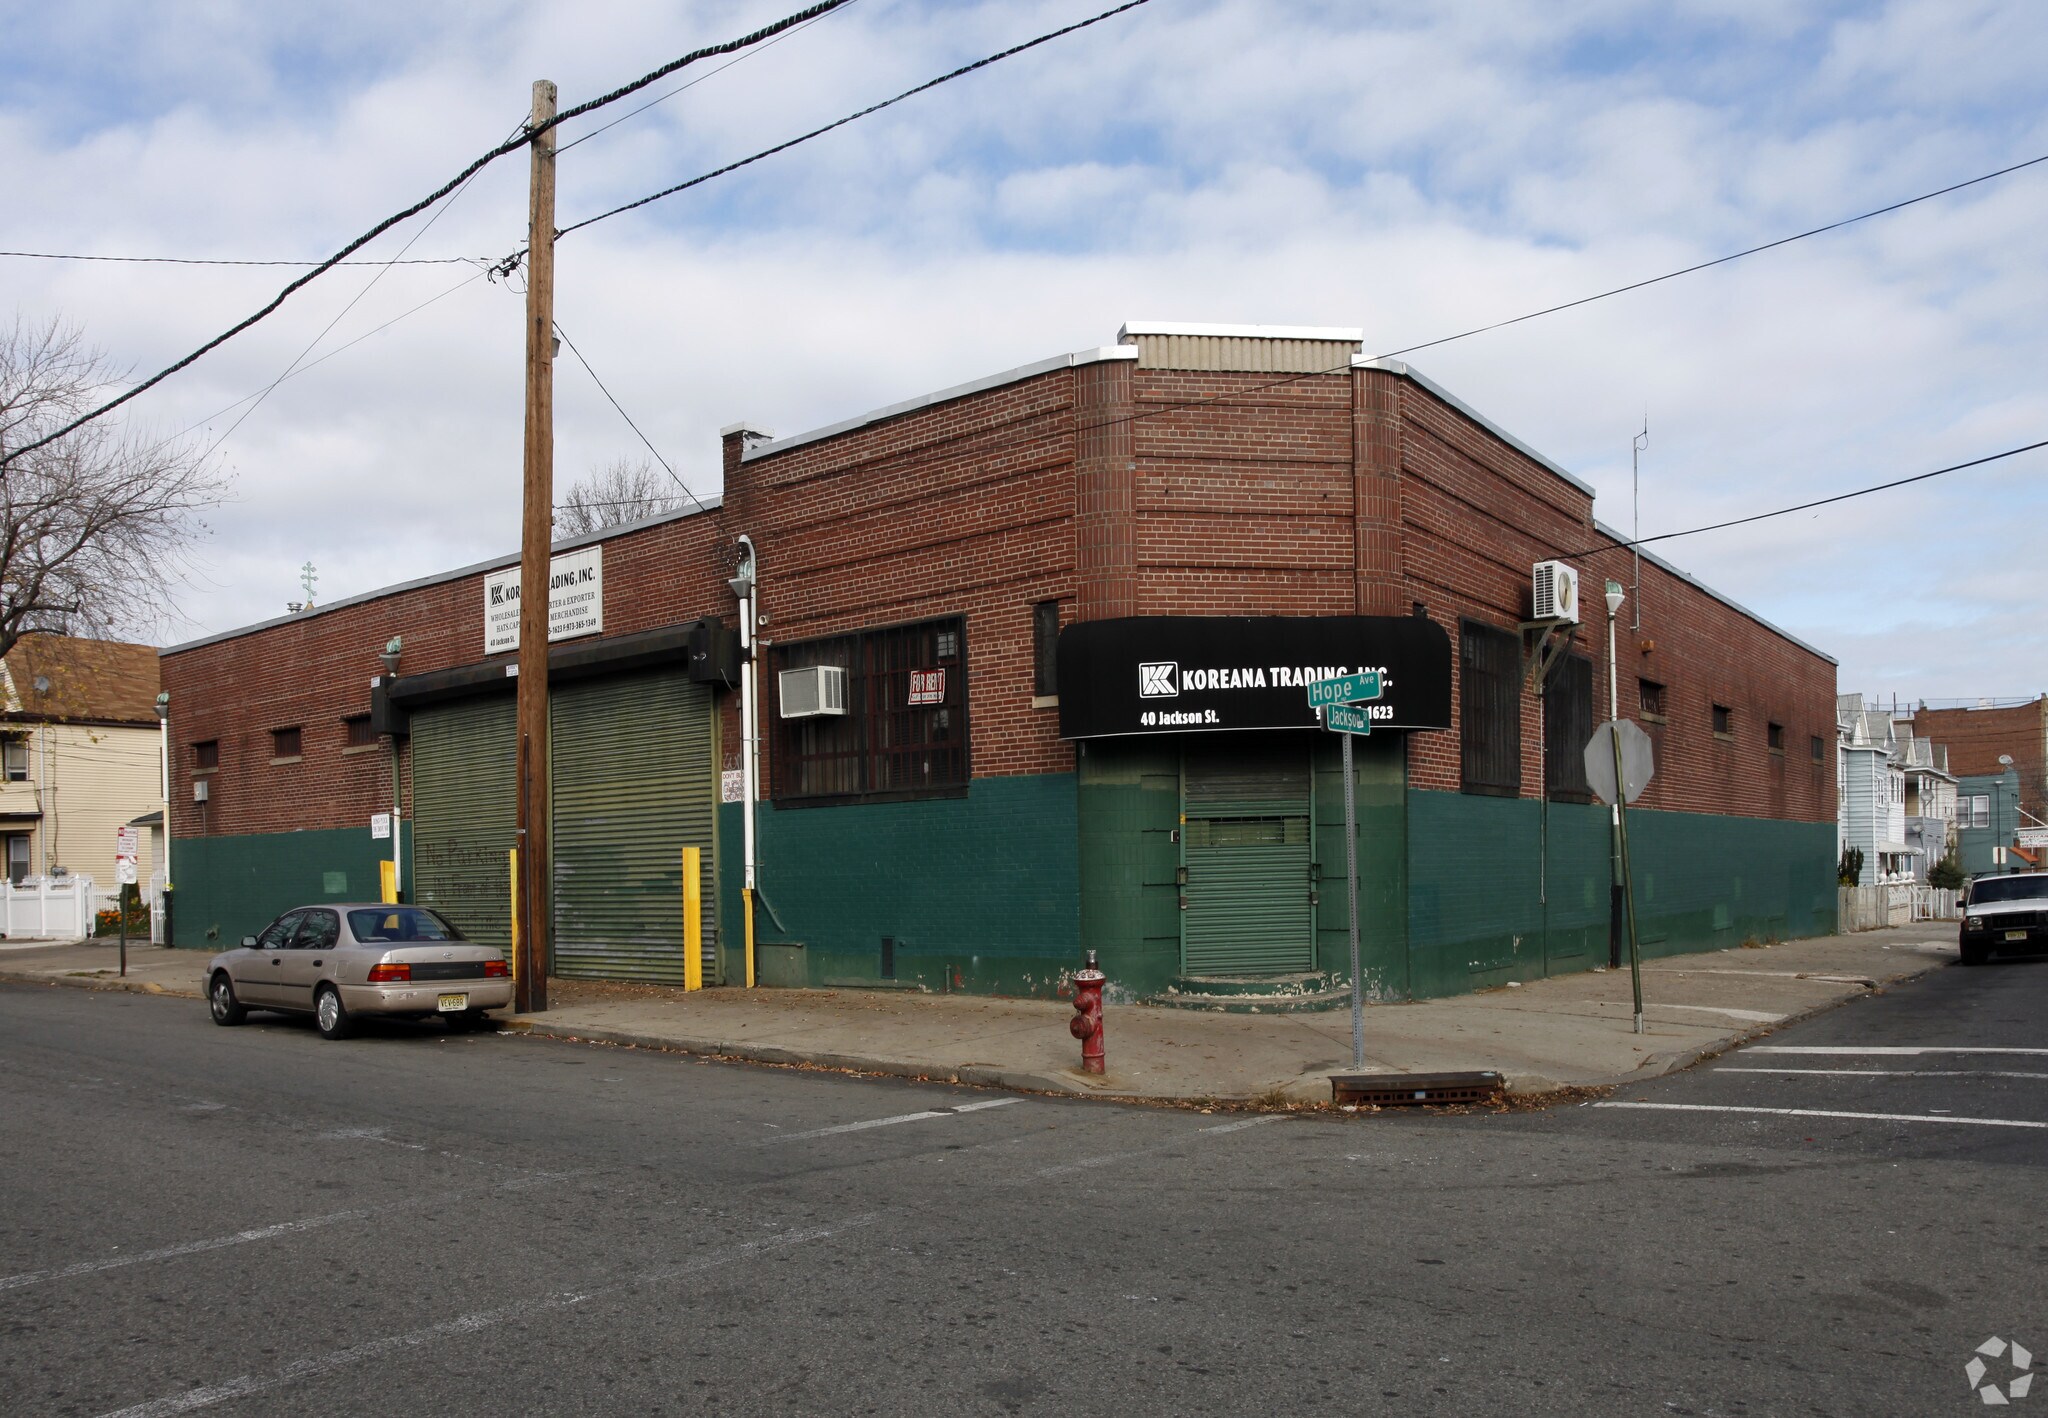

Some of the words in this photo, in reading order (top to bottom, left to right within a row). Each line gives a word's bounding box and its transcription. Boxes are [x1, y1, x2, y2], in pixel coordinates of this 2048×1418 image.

[549, 571, 578, 590] ADING,
[578, 566, 596, 583] INC.
[566, 592, 595, 605] EXPORTER
[550, 606, 588, 621] MERCHANDISE
[912, 673, 925, 692] FOR
[926, 672, 942, 691] RENT
[1182, 668, 1266, 690] KOREANA
[1312, 682, 1352, 702] Hope
[1360, 676, 1374, 685] Ave
[1140, 712, 1156, 726] 40
[1158, 710, 1202, 725] Jackson
[1204, 709, 1220, 724] St.
[1330, 706, 1360, 728] Jackson
